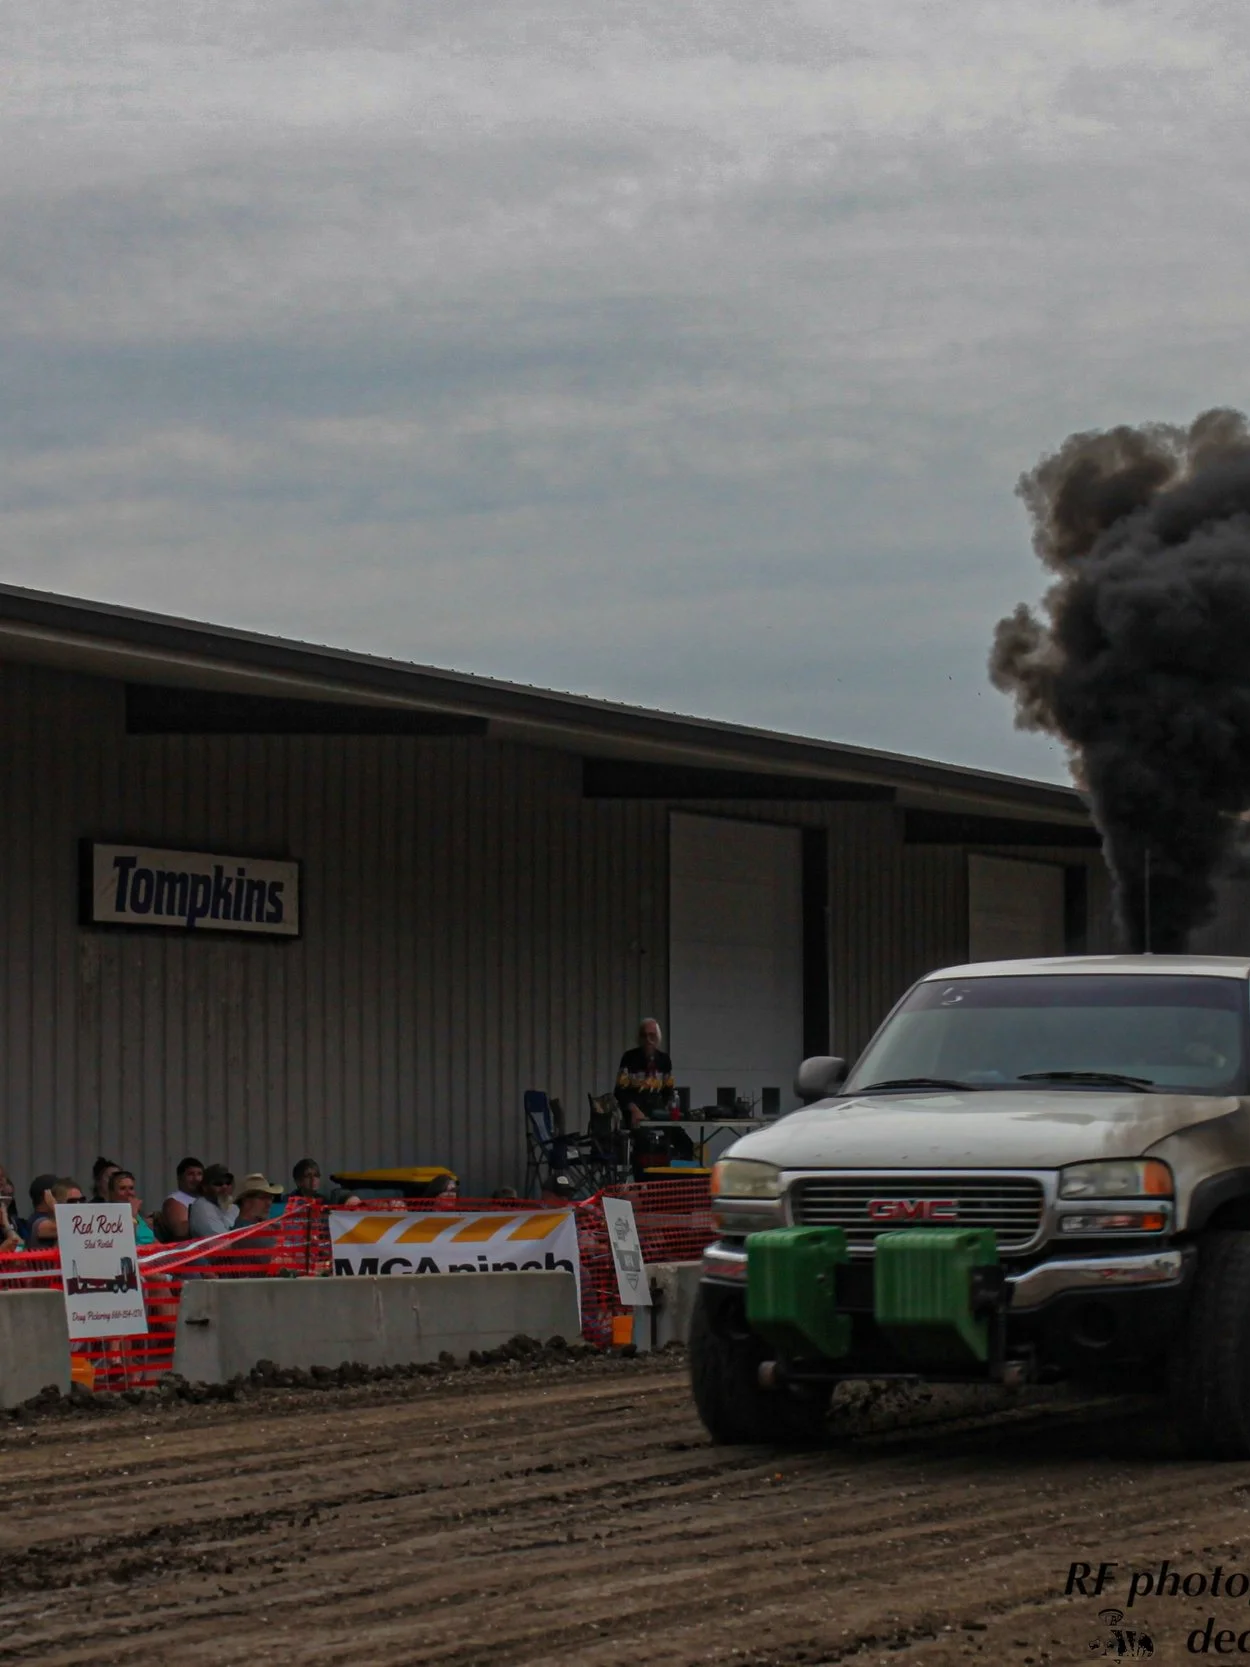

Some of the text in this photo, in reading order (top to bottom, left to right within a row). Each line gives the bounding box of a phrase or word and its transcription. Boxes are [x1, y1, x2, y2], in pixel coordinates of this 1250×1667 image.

[113, 856, 284, 928] Tompkins
[867, 1199, 958, 1220] GMC
[72, 1214, 123, 1235] Red Rock
